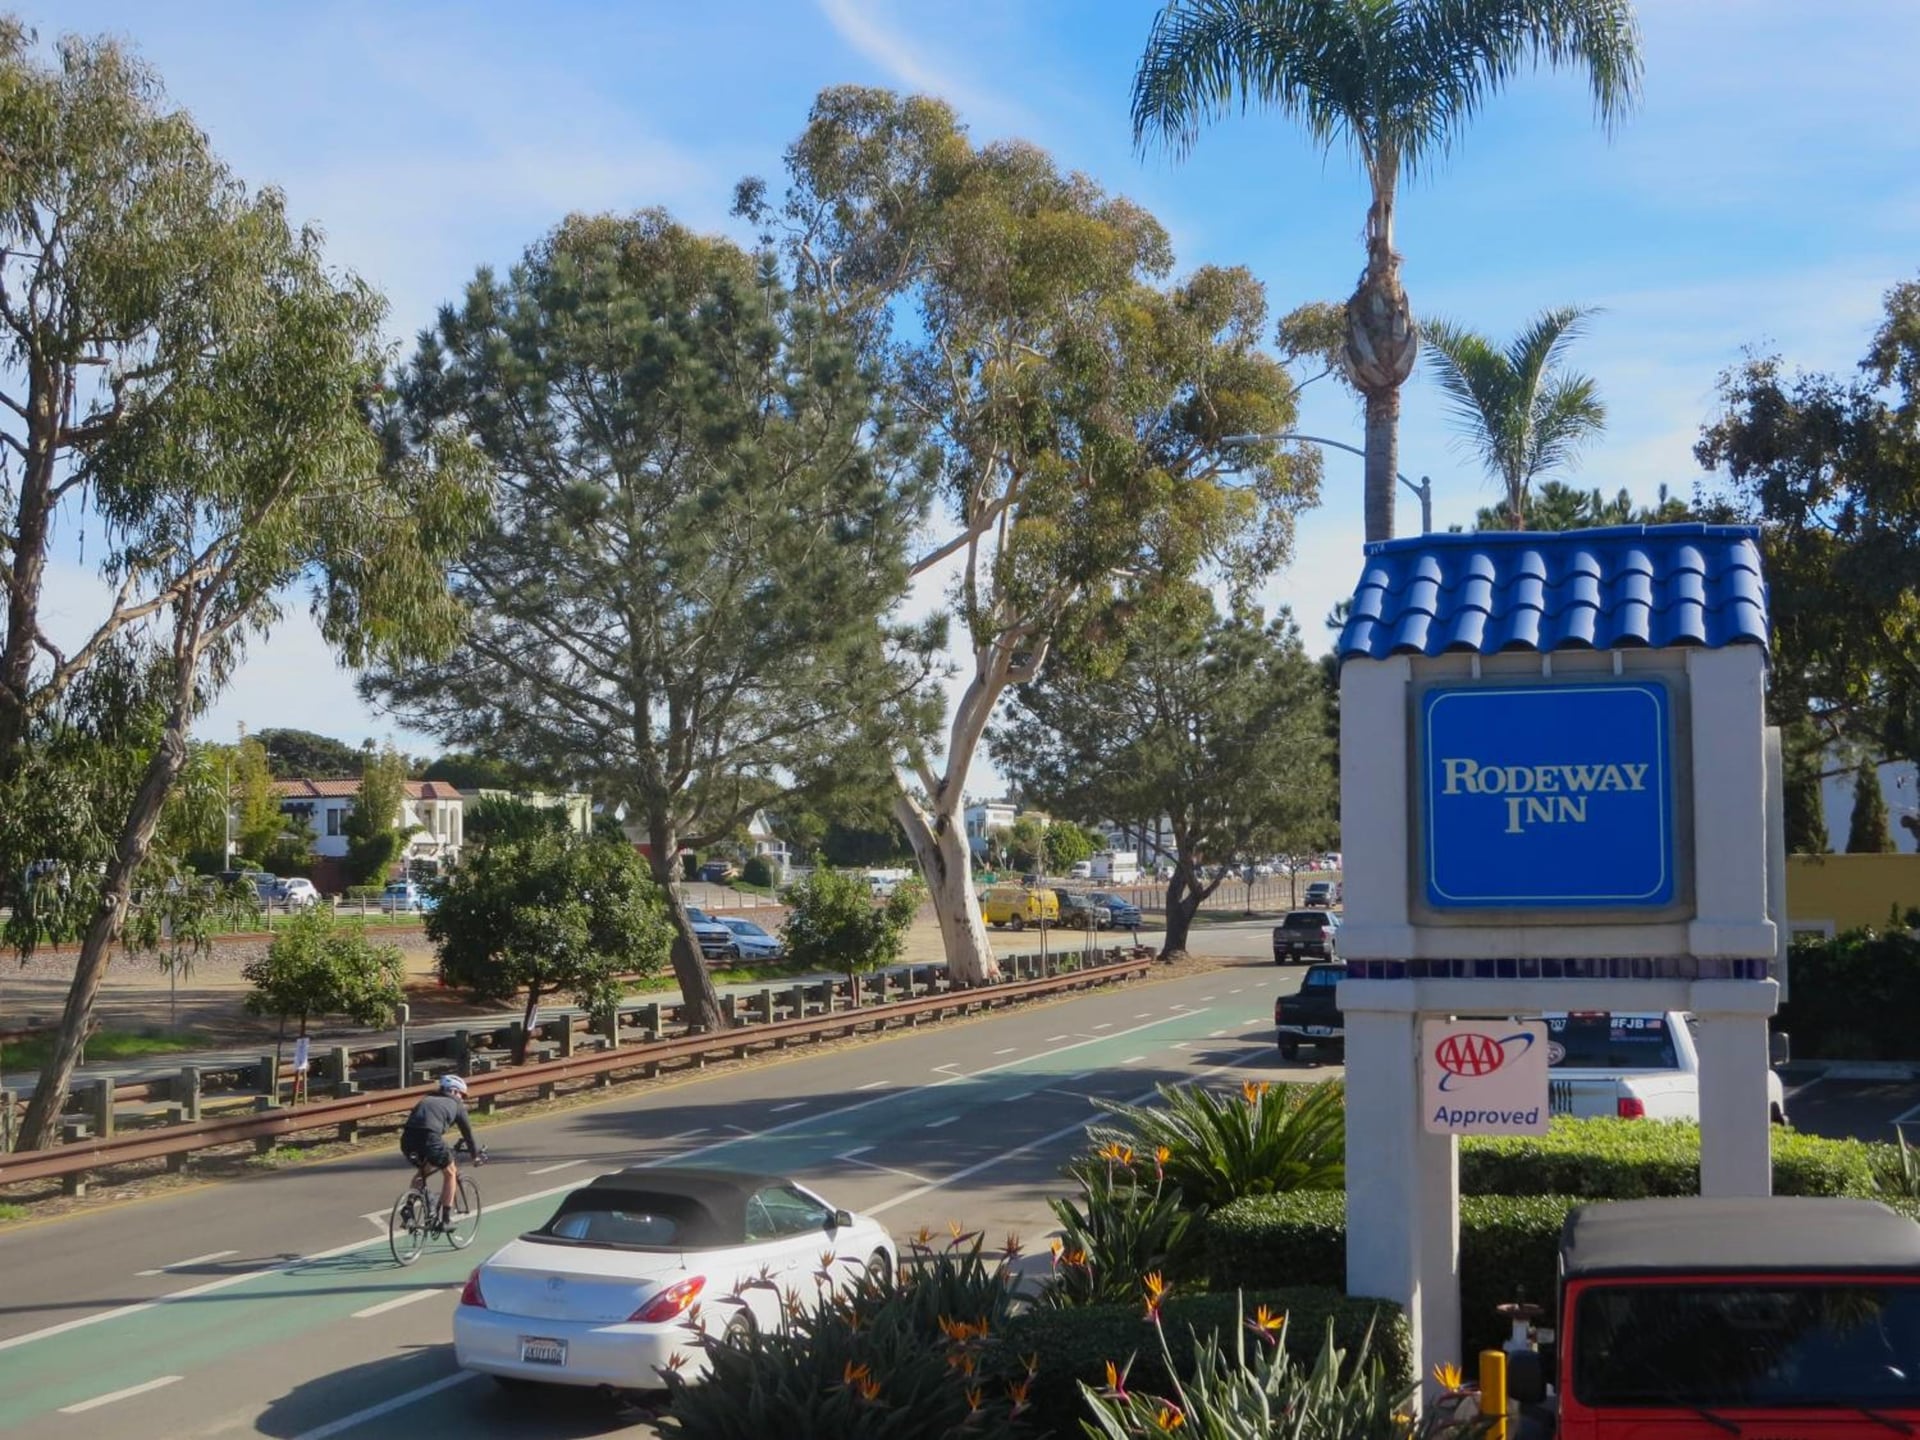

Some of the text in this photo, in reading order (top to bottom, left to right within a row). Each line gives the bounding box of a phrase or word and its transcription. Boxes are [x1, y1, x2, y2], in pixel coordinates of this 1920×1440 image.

[1441, 758, 1649, 795] RODEWAY
[1504, 796, 1588, 833] INN
[1610, 1018, 1645, 1029] #FJB
[1441, 1034, 1500, 1076] AAA
[1433, 1105, 1539, 1128] Approved
